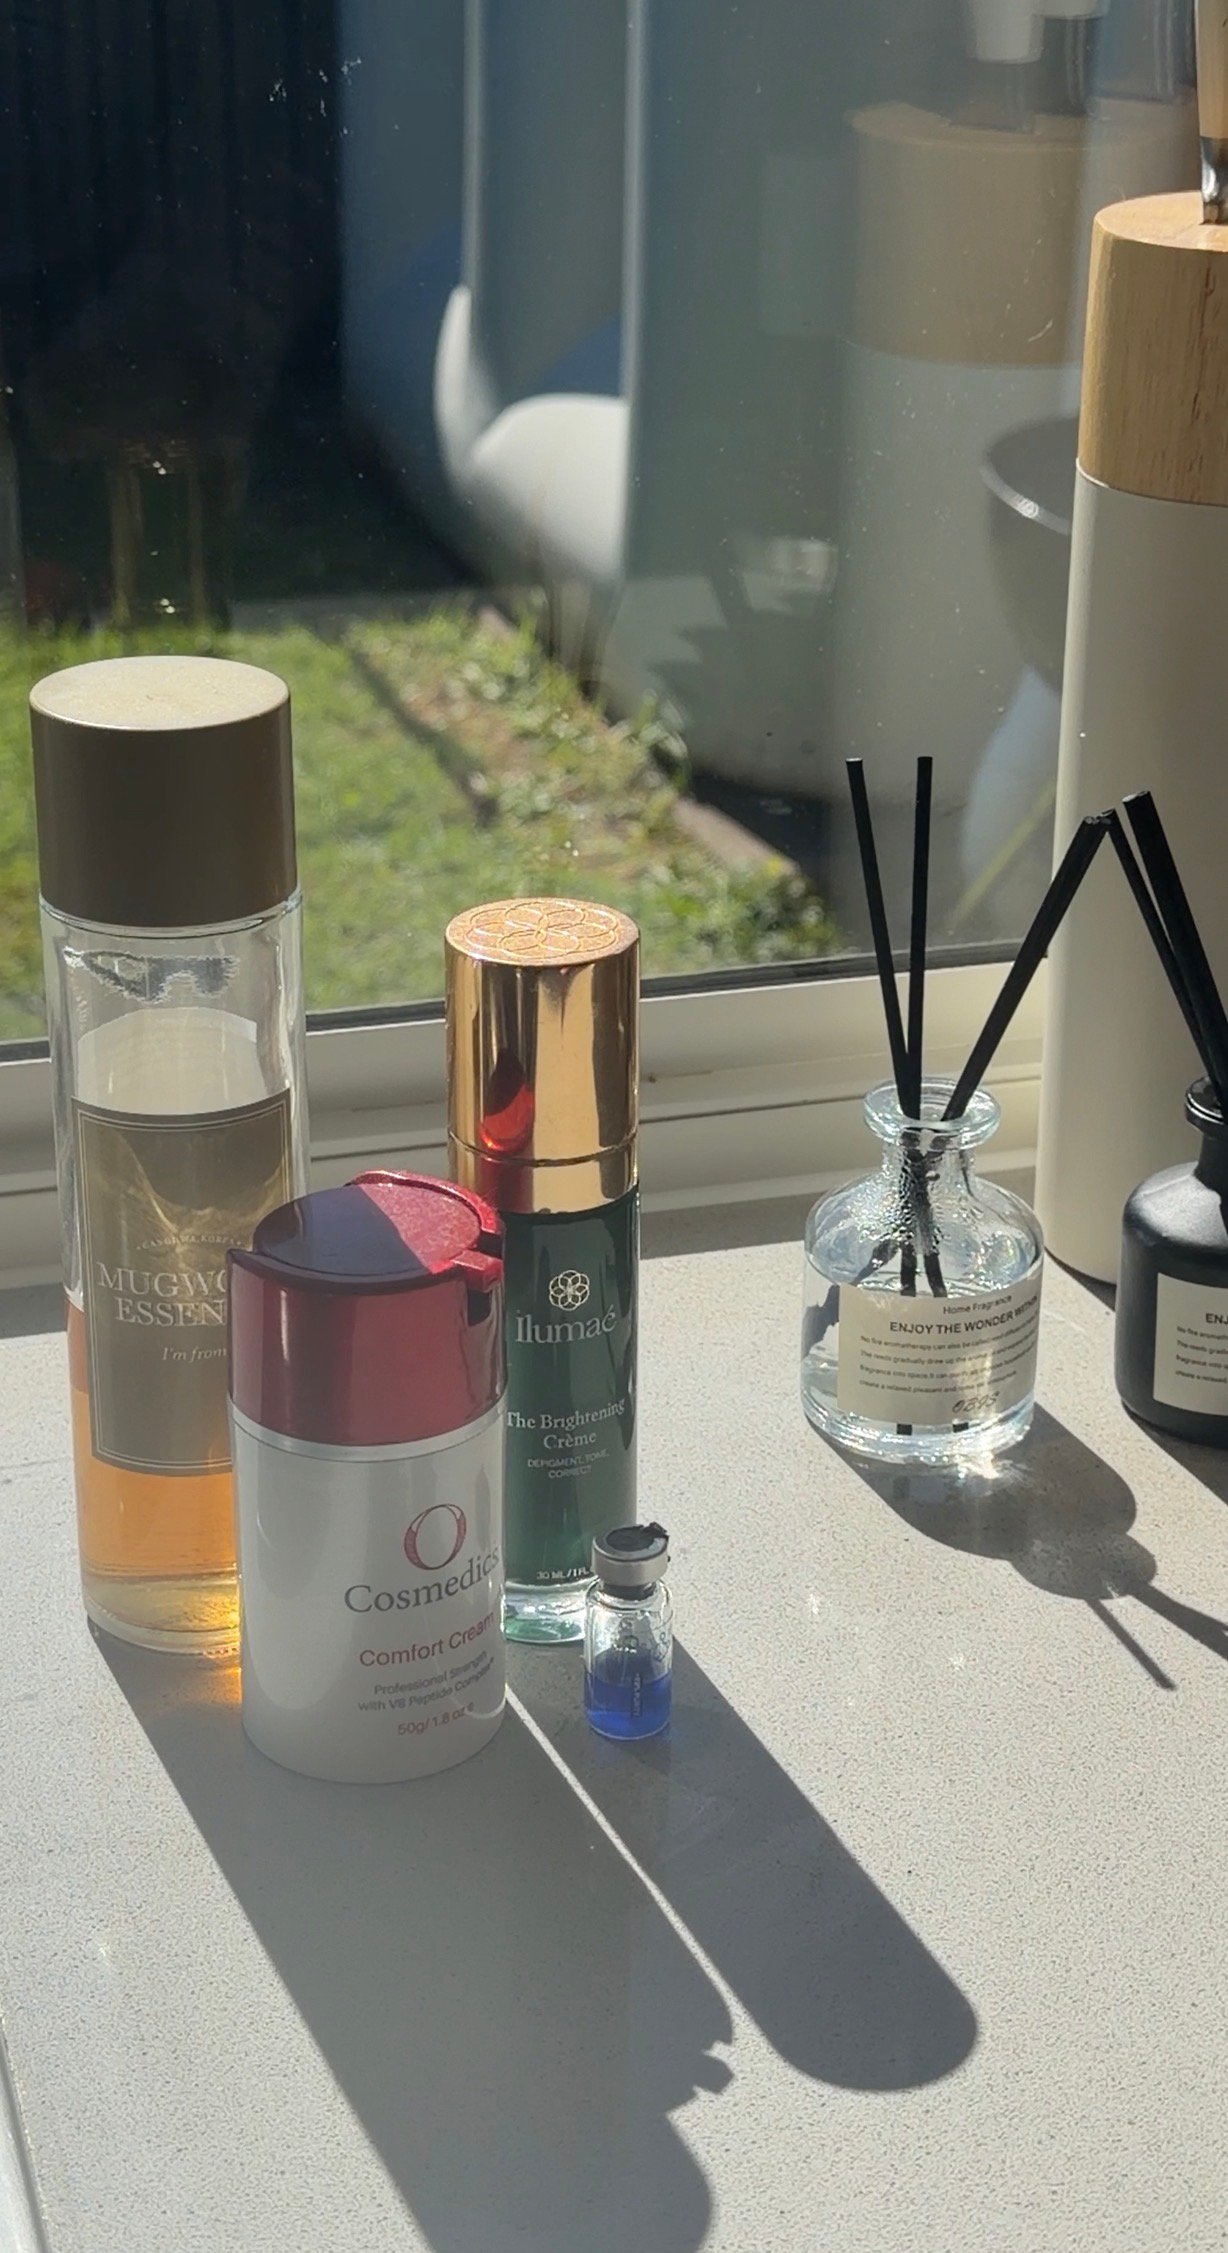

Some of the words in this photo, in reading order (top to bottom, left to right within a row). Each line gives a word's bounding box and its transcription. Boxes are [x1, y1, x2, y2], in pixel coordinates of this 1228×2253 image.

[889, 1321, 934, 1335] ENJOY
[935, 1323, 961, 1335] THE
[964, 1310, 1014, 1332] WONDER
[942, 1306, 971, 1315] Home
[162, 1347, 187, 1361] I'm
[540, 1399, 625, 1432] Brightening
[543, 1432, 598, 1450] Crème
[344, 1547, 500, 1613] Cosmedics
[359, 1638, 445, 1668] Comfort
[448, 1611, 496, 1650] Cream
[373, 1671, 447, 1695] Professional
[358, 1700, 387, 1711] with
[408, 1686, 453, 1706] Peptide
